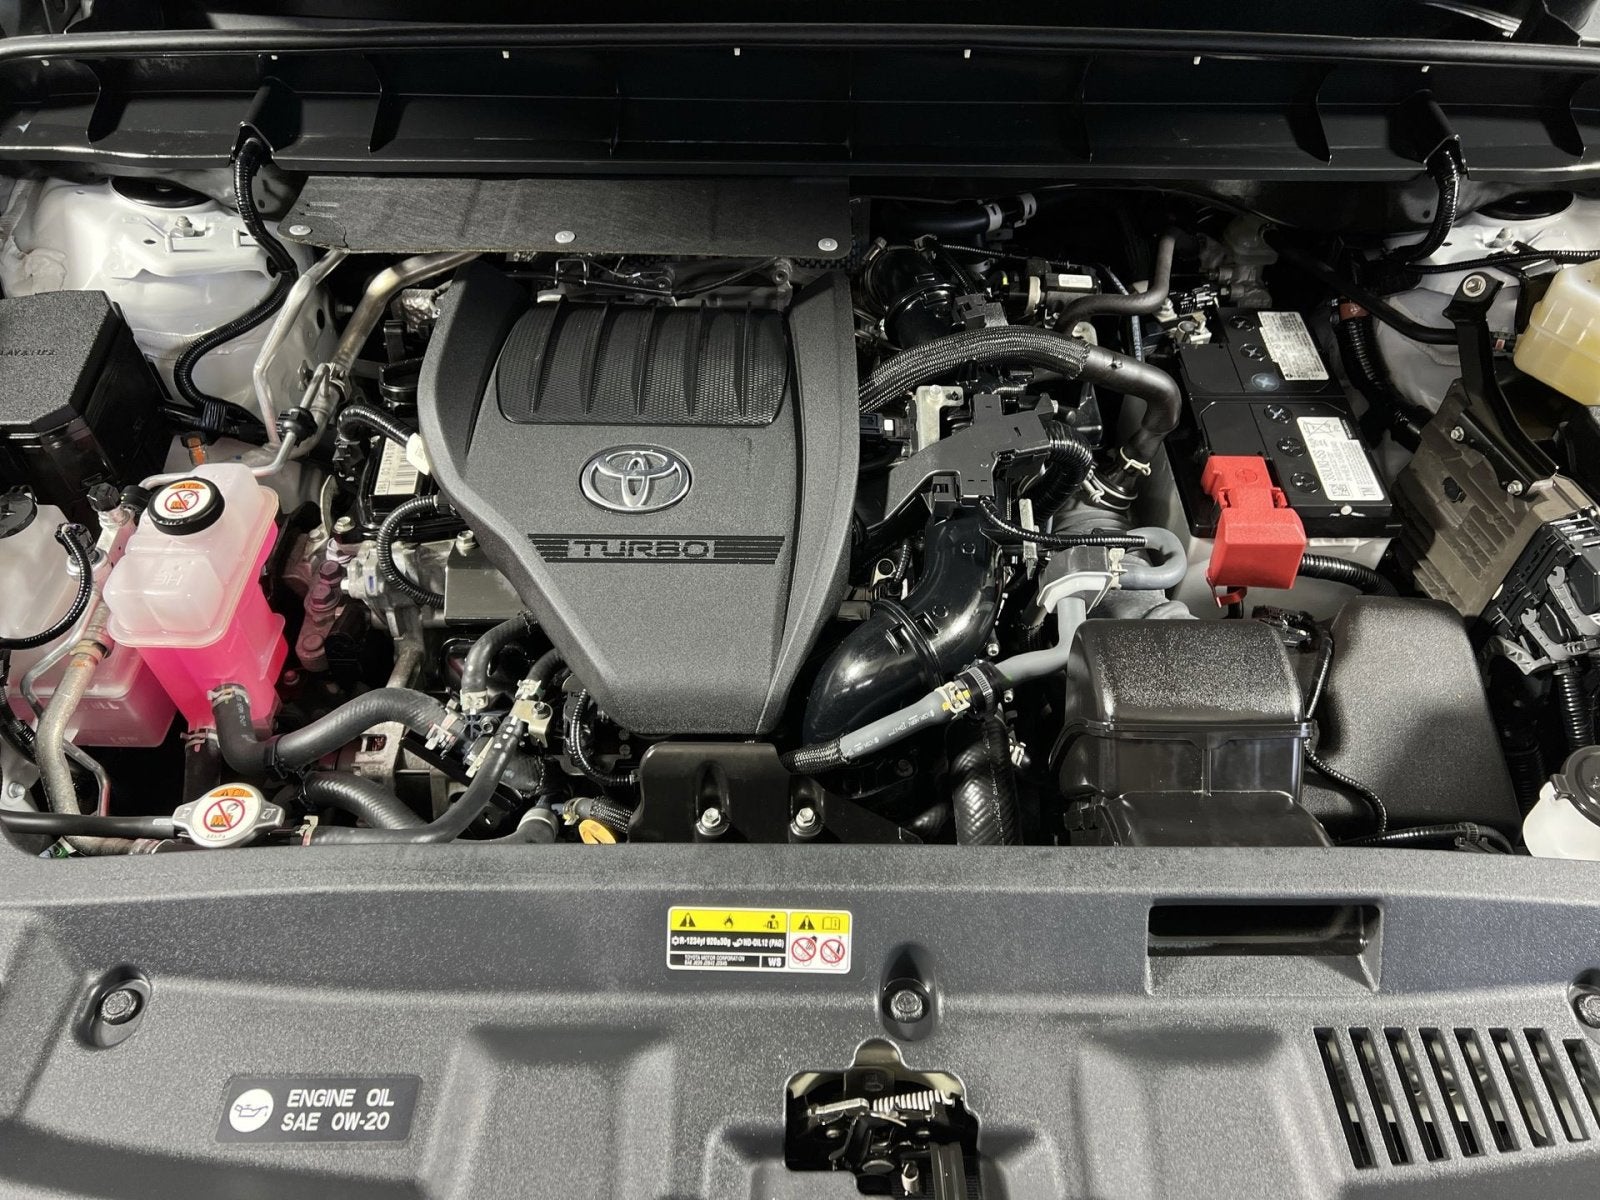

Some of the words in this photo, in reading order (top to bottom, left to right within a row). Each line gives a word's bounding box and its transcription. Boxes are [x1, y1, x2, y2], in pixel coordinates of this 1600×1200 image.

[573, 540, 710, 557] TURBO
[286, 1088, 356, 1107] ENGINE
[366, 1088, 394, 1107] OIL
[280, 1112, 321, 1131] SAE
[331, 1111, 390, 1131] 0W-20
